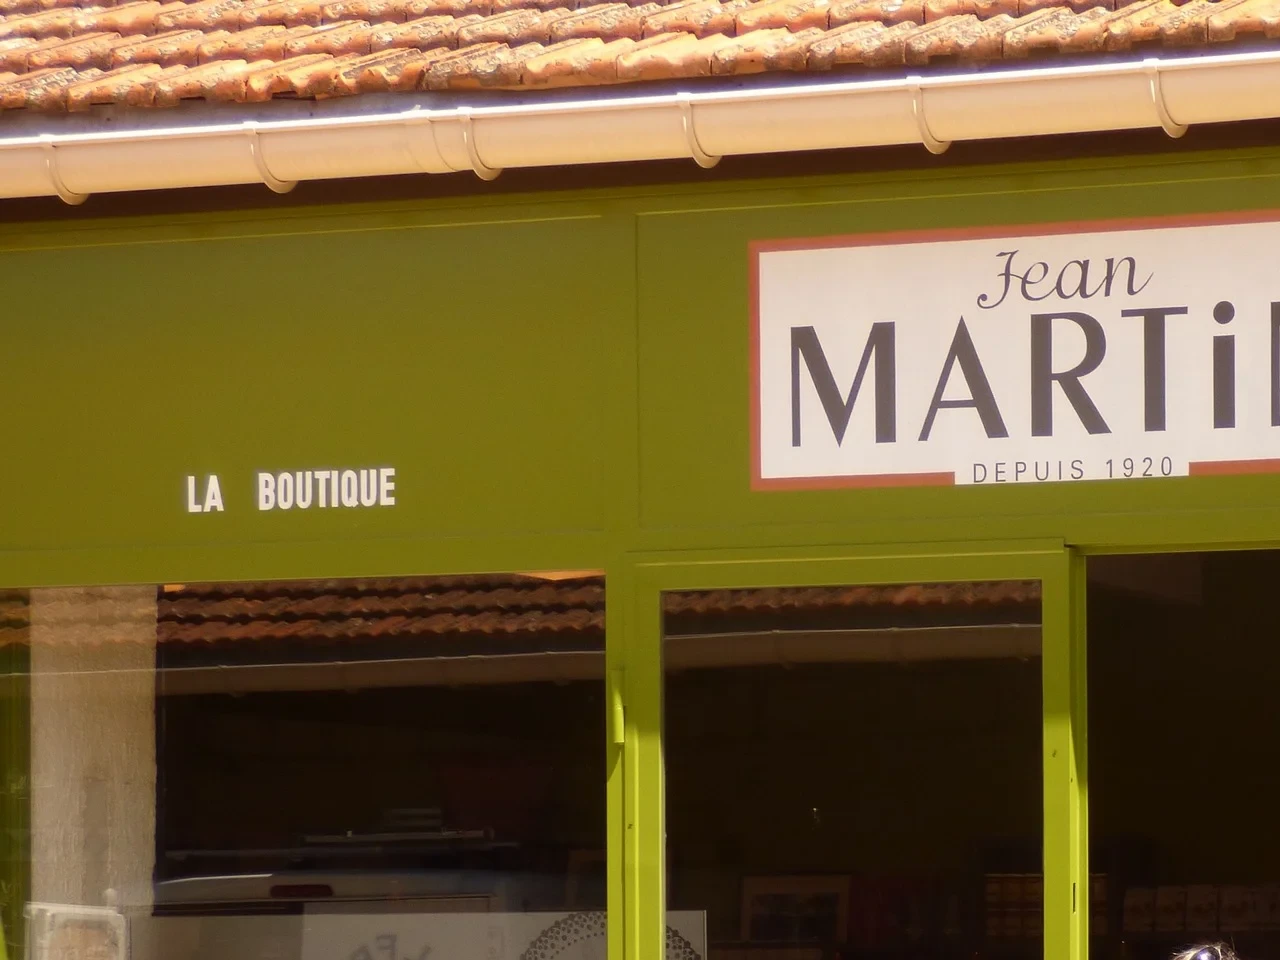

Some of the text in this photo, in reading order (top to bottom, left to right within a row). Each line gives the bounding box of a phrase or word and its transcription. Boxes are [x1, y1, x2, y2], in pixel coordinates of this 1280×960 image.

[977, 249, 1153, 309] Jean
[188, 468, 396, 513] LA BOUTIQUE
[973, 456, 1174, 484] DEPUIS 1920
